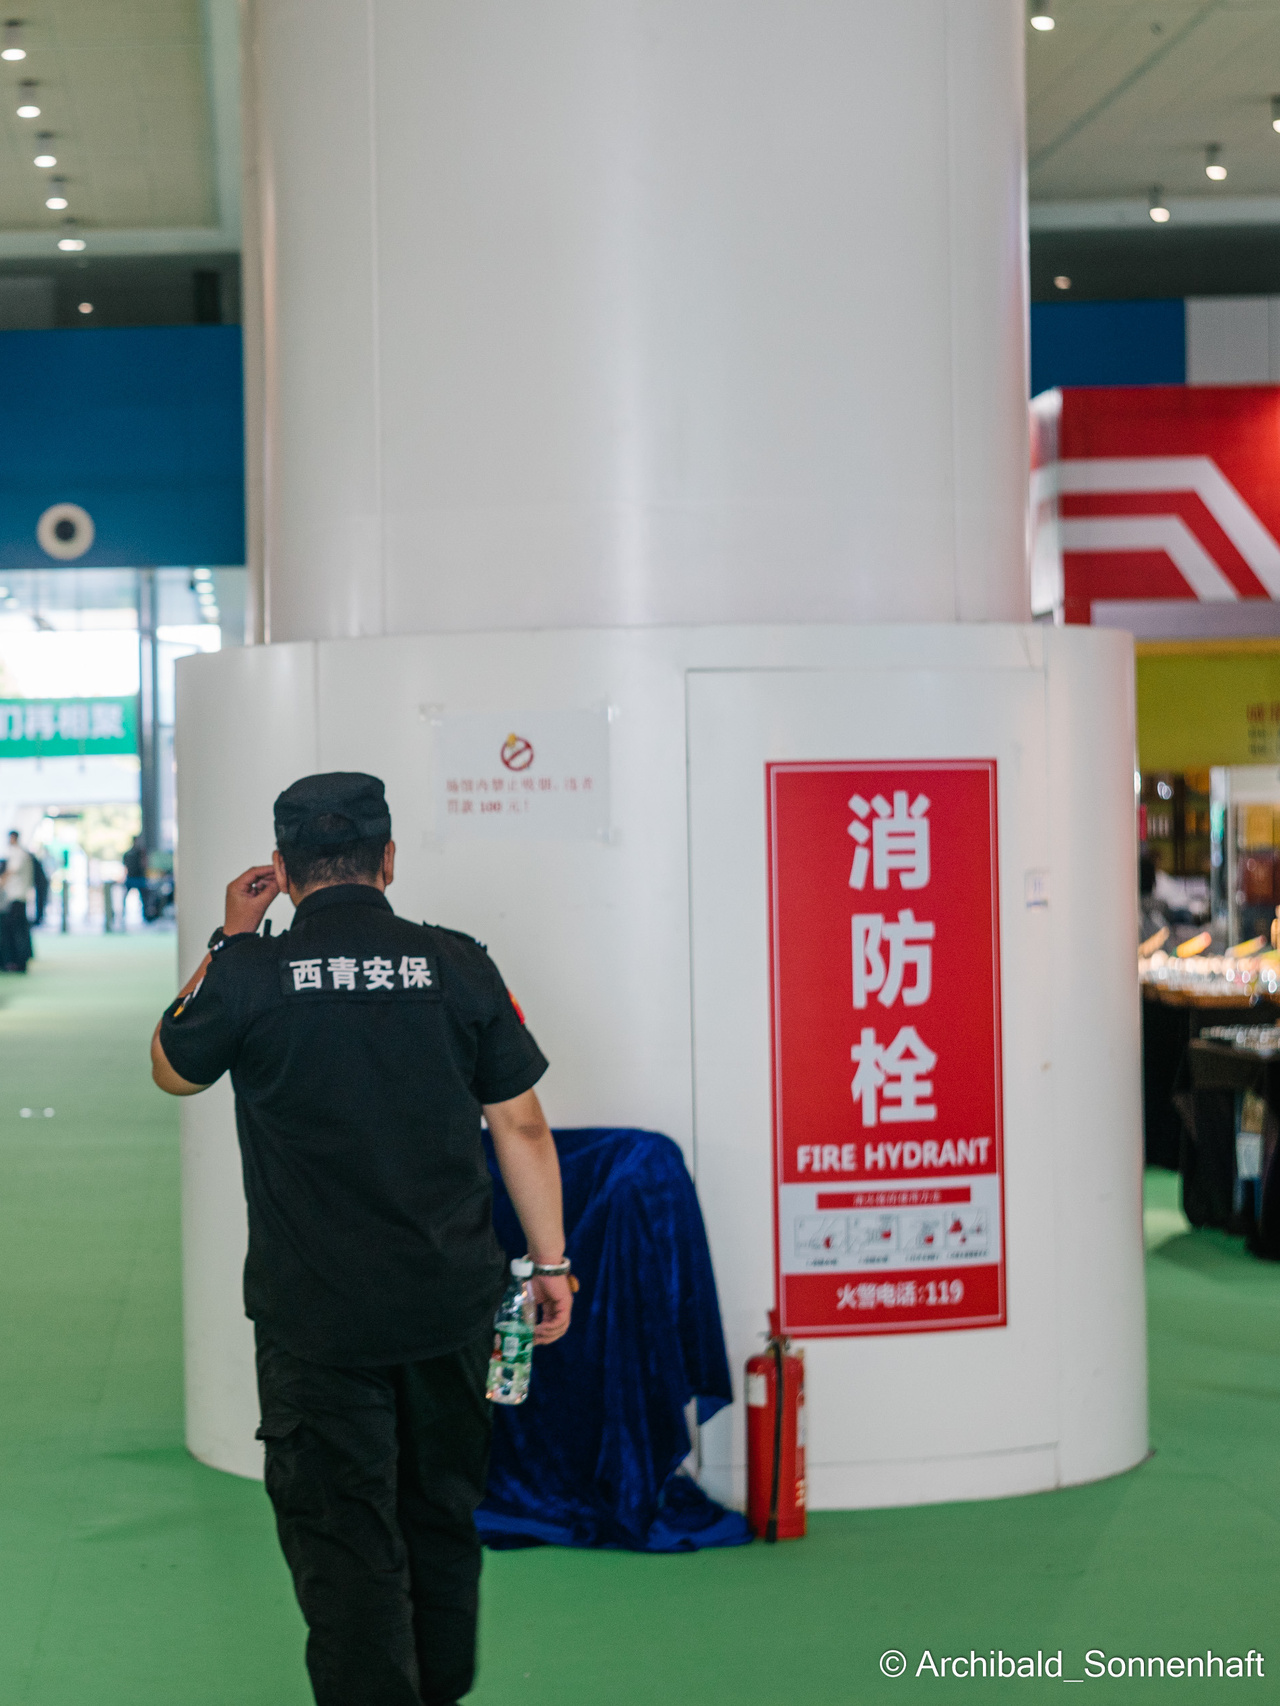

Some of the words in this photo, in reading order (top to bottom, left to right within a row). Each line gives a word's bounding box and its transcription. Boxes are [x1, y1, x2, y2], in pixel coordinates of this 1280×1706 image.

[289, 955, 433, 991] 西青安保
[847, 790, 937, 1127] 消防栓
[796, 1143, 857, 1173] FIRE
[864, 1137, 991, 1170] HYDRANT
